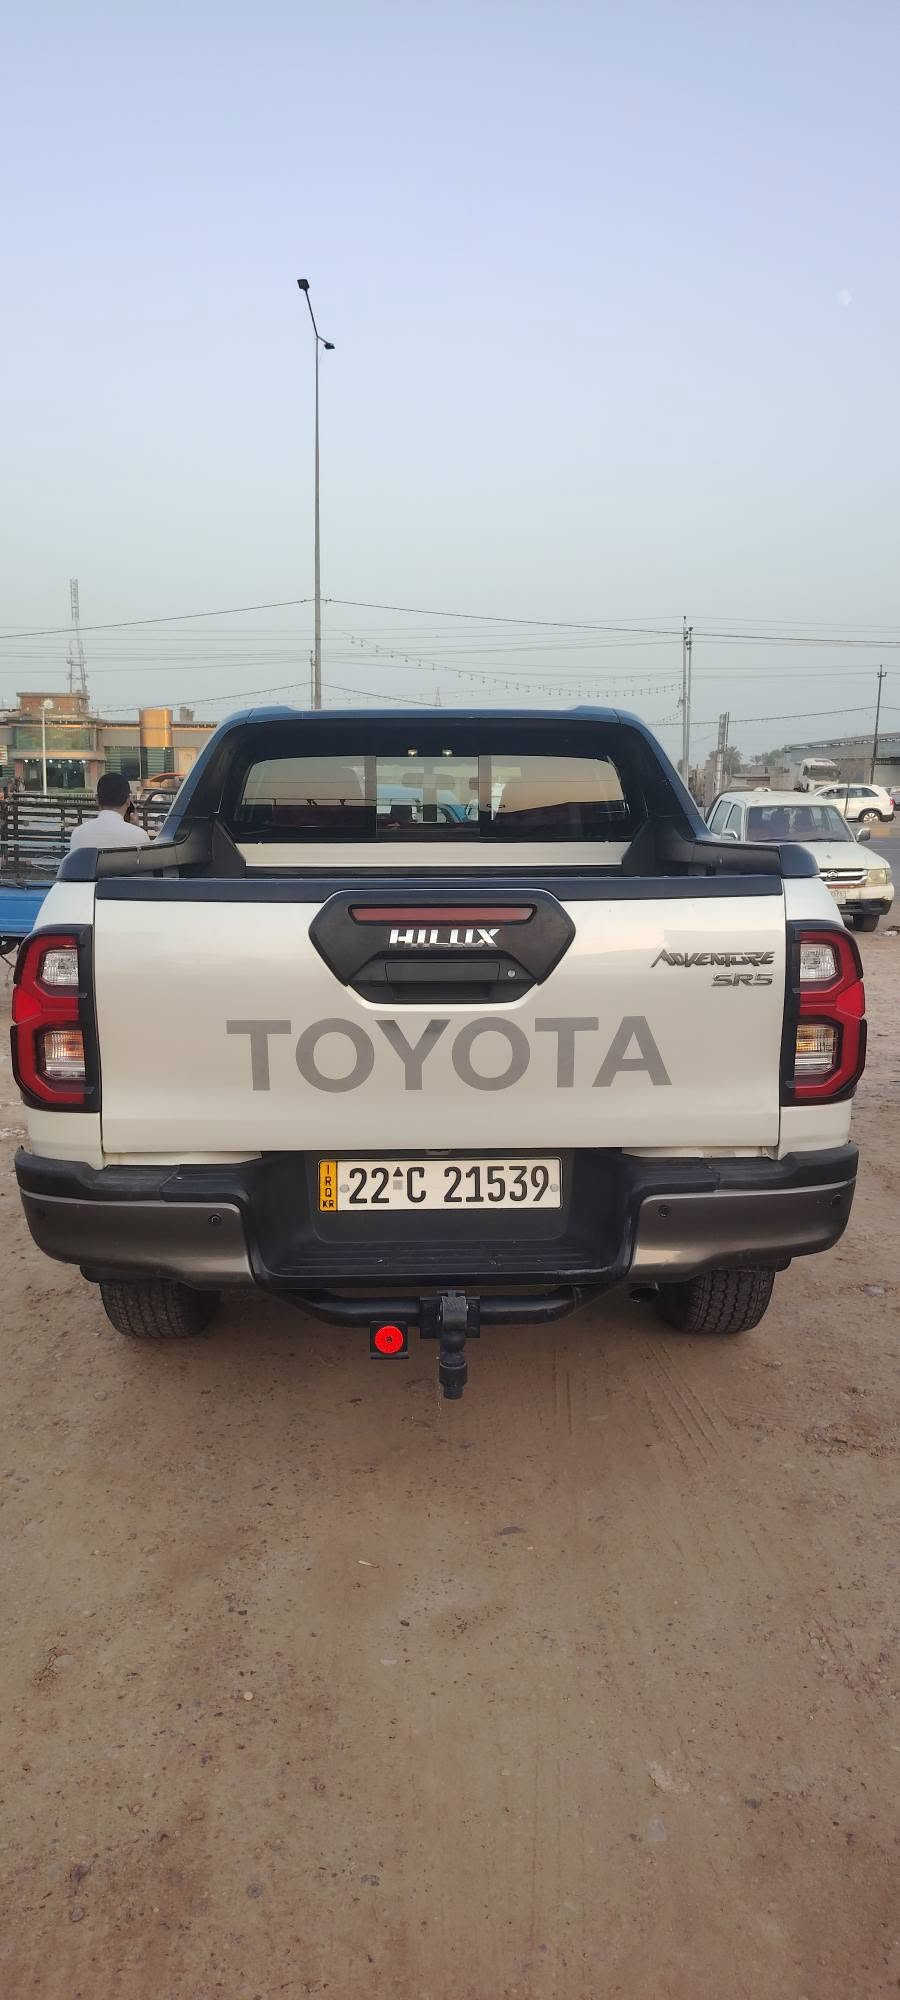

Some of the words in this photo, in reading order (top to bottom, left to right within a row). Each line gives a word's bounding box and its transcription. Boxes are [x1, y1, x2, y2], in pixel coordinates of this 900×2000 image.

[389, 928, 500, 947] HILUX
[651, 949, 775, 968] ADVENTURE
[226, 1016, 672, 1093] TOYOTA
[349, 1167, 389, 1204] 22
[406, 1166, 427, 1203] C
[443, 1165, 550, 1203] 21539
